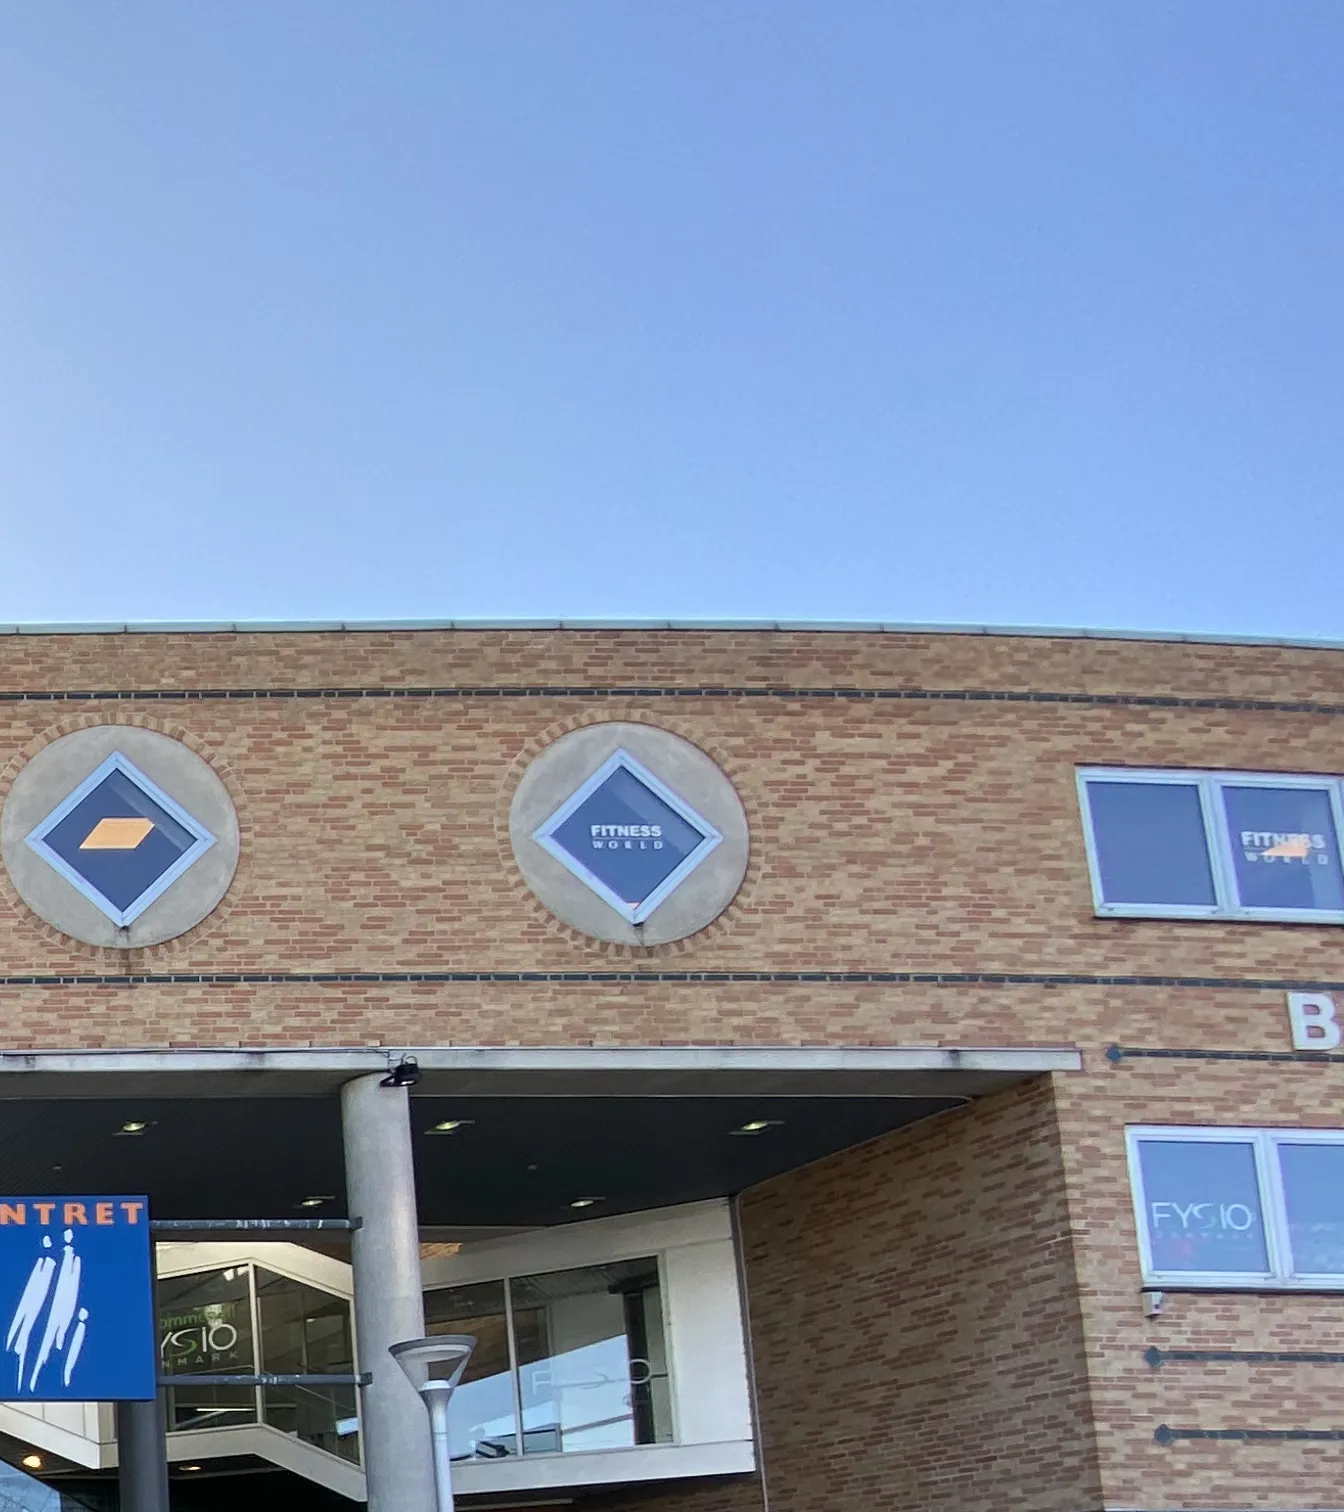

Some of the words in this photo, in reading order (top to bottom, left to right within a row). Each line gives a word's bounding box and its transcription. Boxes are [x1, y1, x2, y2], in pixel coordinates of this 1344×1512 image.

[591, 825, 662, 837] FITNESS
[592, 840, 663, 850] WORLD
[1152, 1202, 1253, 1230] FYSIO
